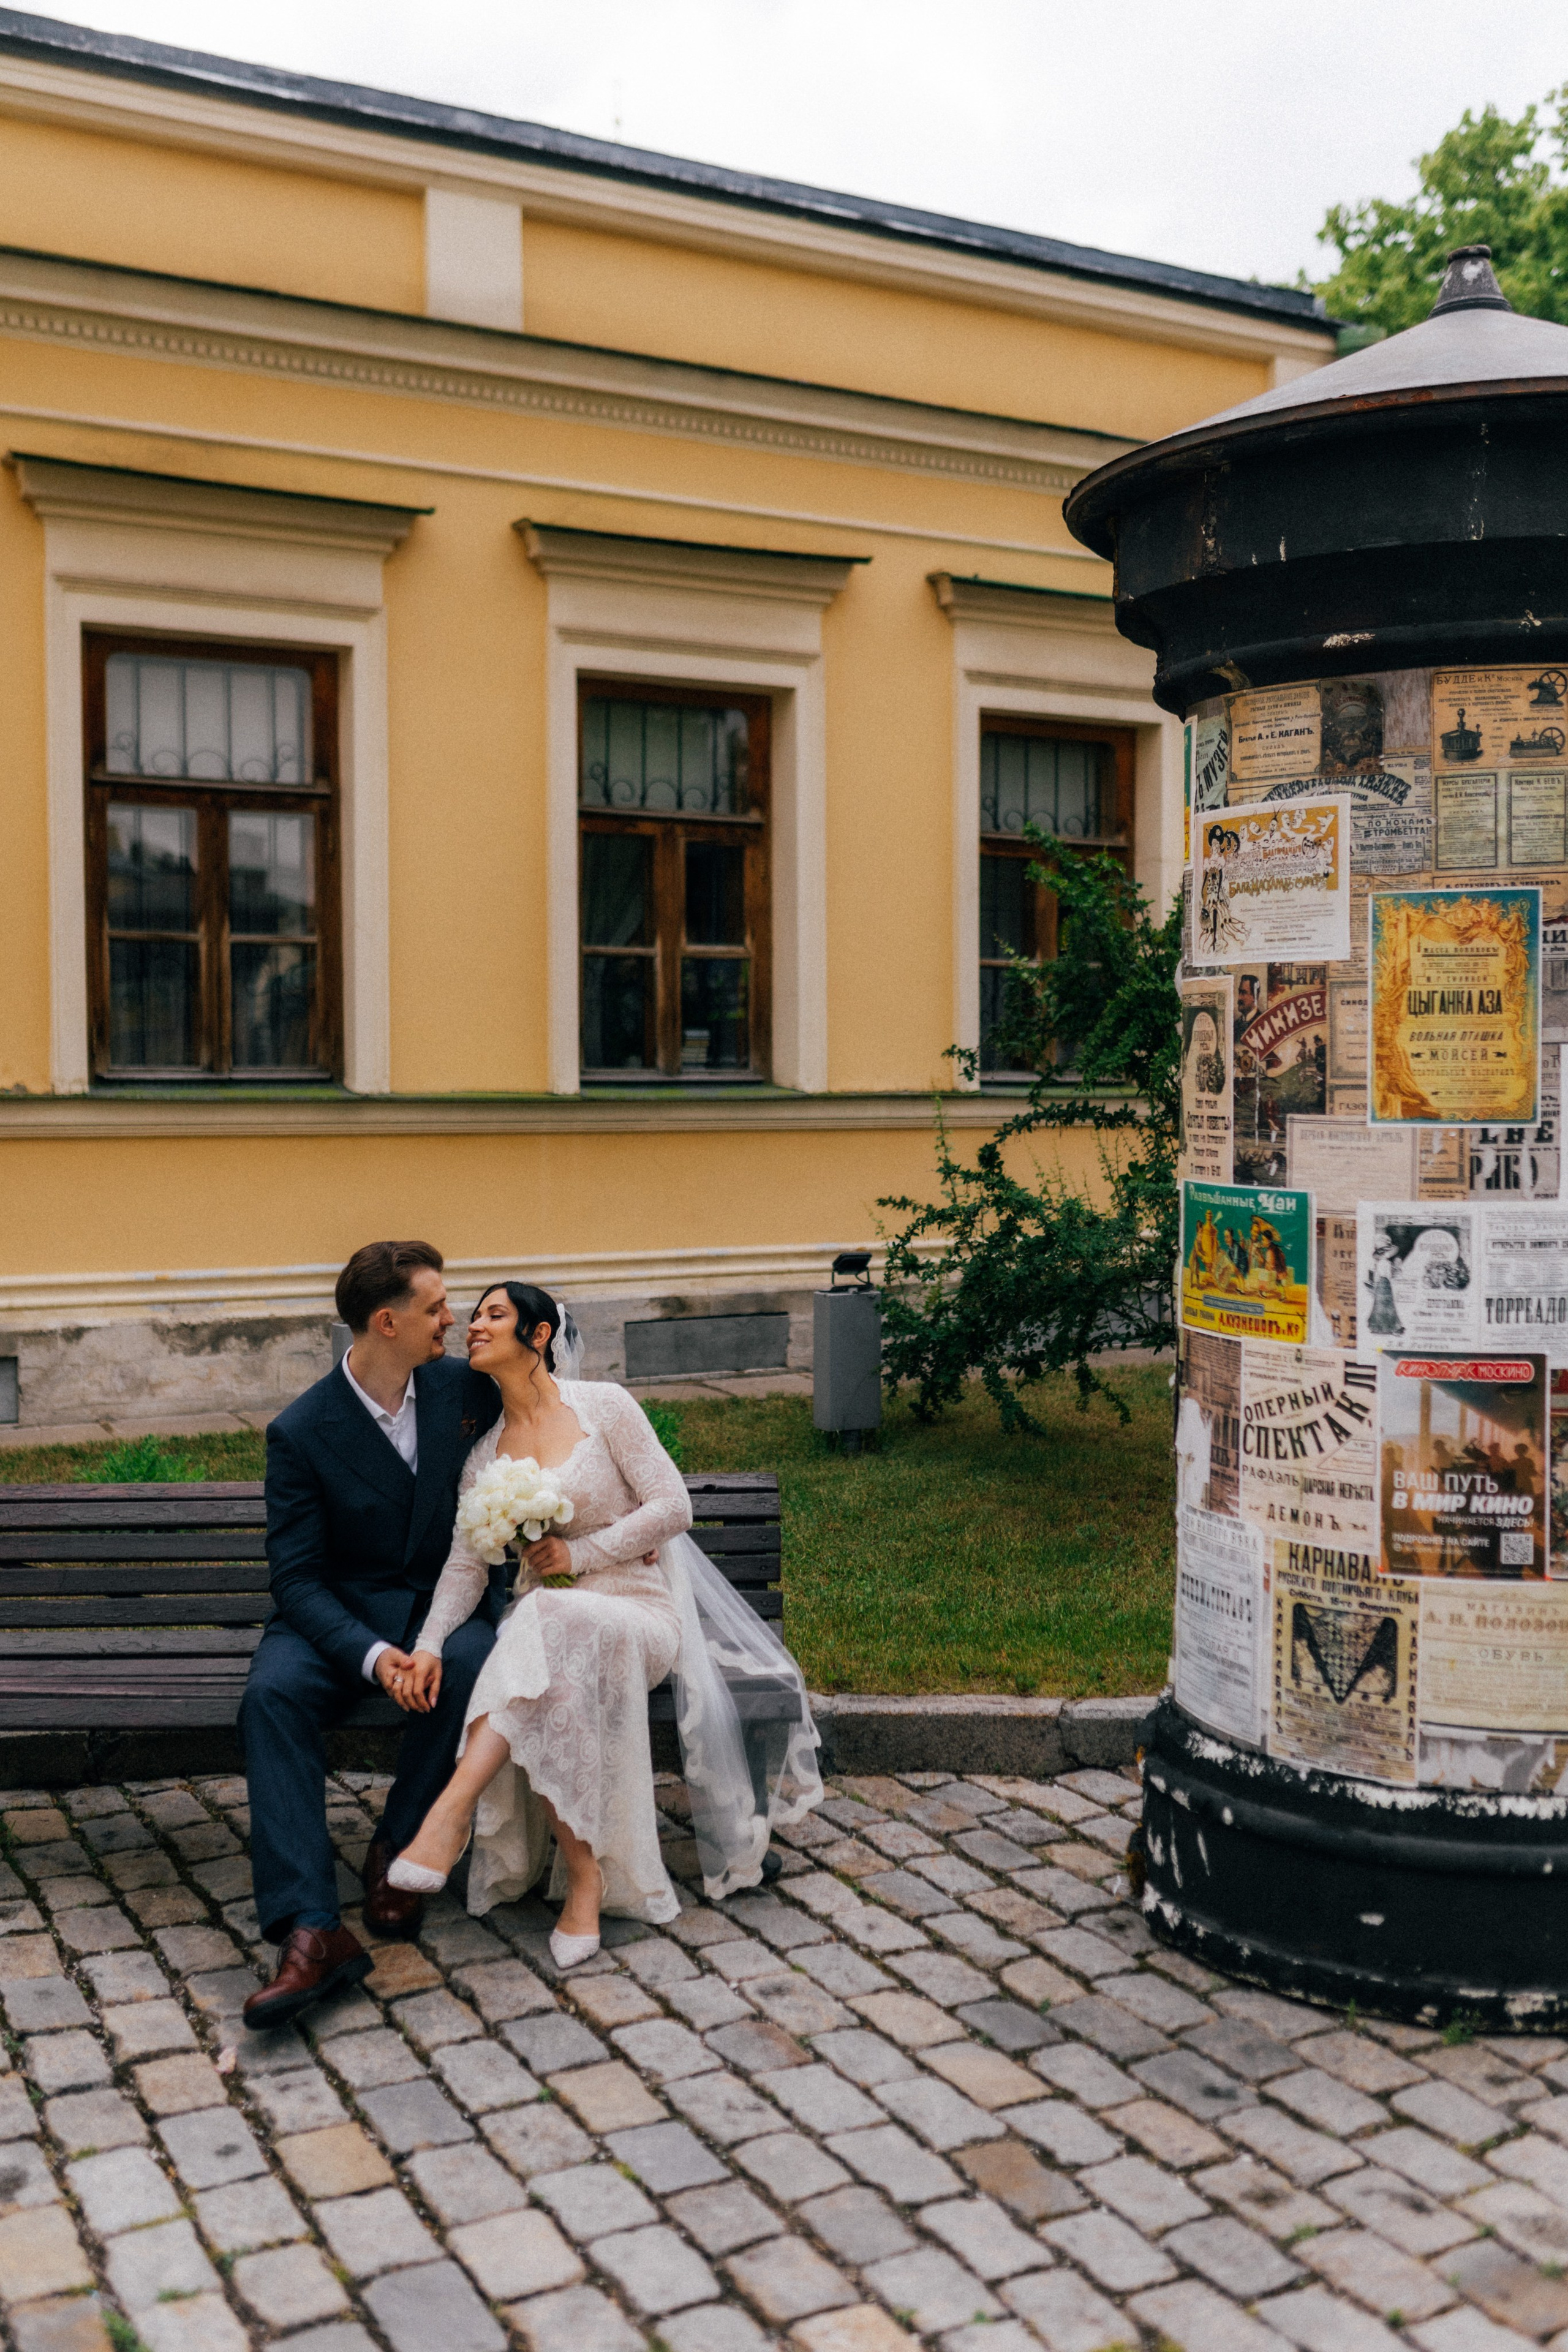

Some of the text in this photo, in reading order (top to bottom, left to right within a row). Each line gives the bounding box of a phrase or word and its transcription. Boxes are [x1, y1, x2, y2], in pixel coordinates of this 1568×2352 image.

[1436, 674, 1476, 685] БУДДЕ
[1386, 818, 1433, 826] НОЧАМЪ
[1374, 827, 1426, 837] ТРОМБЕТТА
[1408, 989, 1502, 1019] ЦЫГАНКА АЗА
[1245, 993, 1327, 1050] ЧИНИЗЕ
[1409, 1031, 1504, 1042] ВОЛЬНАЯ ПТАШКА
[1398, 1363, 1531, 1378] КИНОПАРК МОСКИНО
[1244, 1381, 1335, 1423] ОПЕРНЫЙ
[1242, 1464, 1300, 1487] РАФАЭЛЬ
[1392, 1469, 1499, 1494] ВАШ ПУТЬ
[1391, 1490, 1534, 1515] В МИР КИНО
[1267, 1502, 1342, 1532] ДЕМОНЪ
[1435, 1515, 1534, 1529] НАЧИНАЕТСЯ ЗДЕСЬ!
[1392, 1532, 1491, 1548] ПОДРОБНЕЕ НА САЙТЕ
[1288, 1542, 1404, 1586] КАРНАВА
[1389, 1589, 1420, 1605] КЛУБА
[1467, 1603, 1561, 1616] МАГАЗИНЪ
[1479, 1648, 1544, 1662] ОБУВЬ
